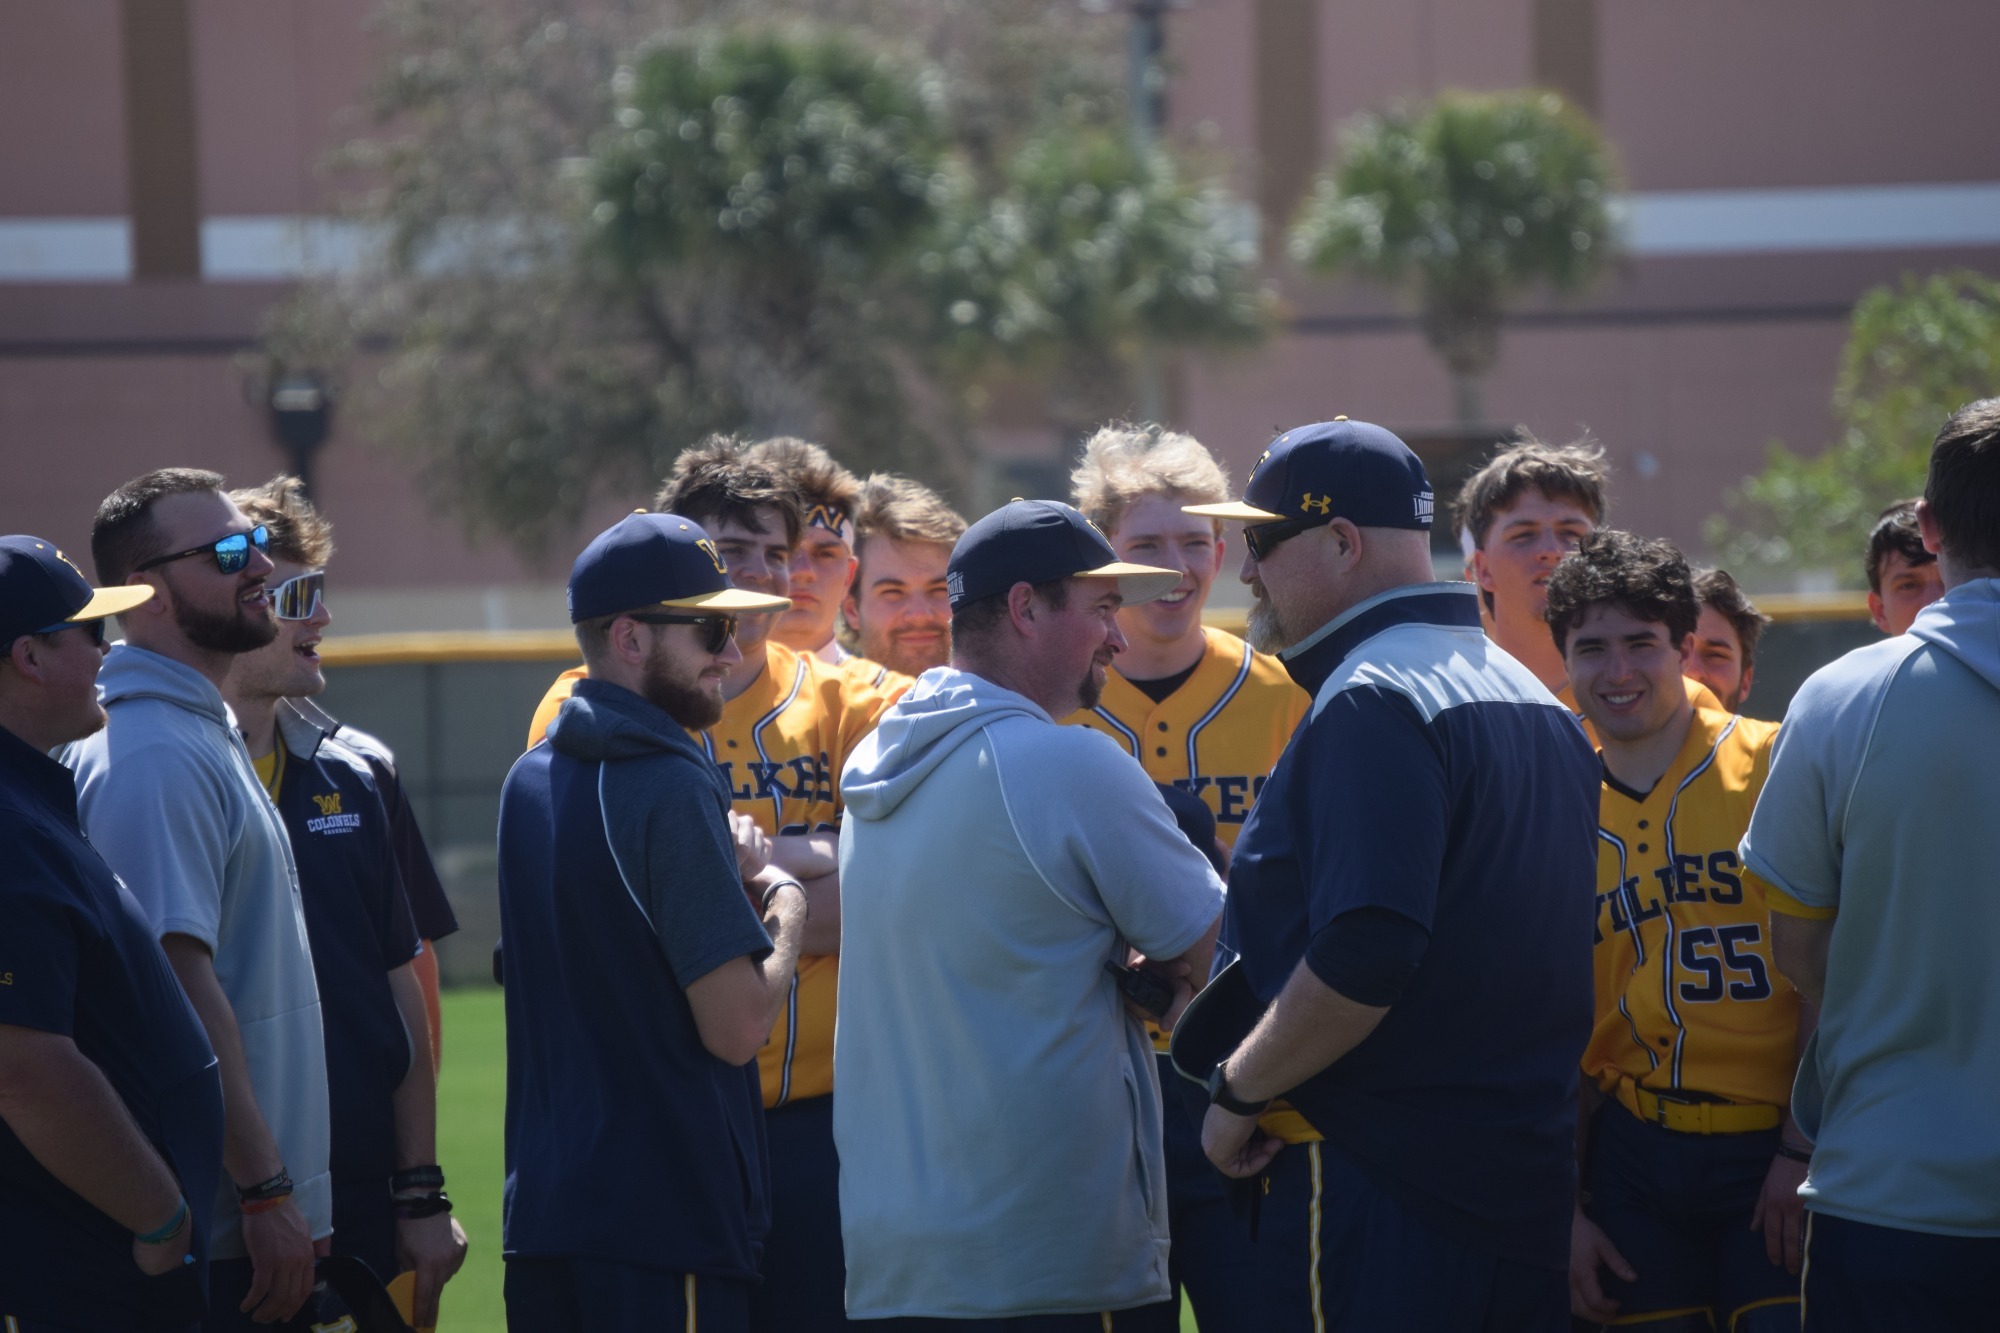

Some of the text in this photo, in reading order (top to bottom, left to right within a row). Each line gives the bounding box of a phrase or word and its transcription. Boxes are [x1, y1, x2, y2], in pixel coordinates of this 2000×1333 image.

[312, 793, 341, 815] W
[307, 813, 360, 833] COLONELS
[323, 827, 353, 836] BASEBALL
[1679, 924, 1772, 1003] 55
